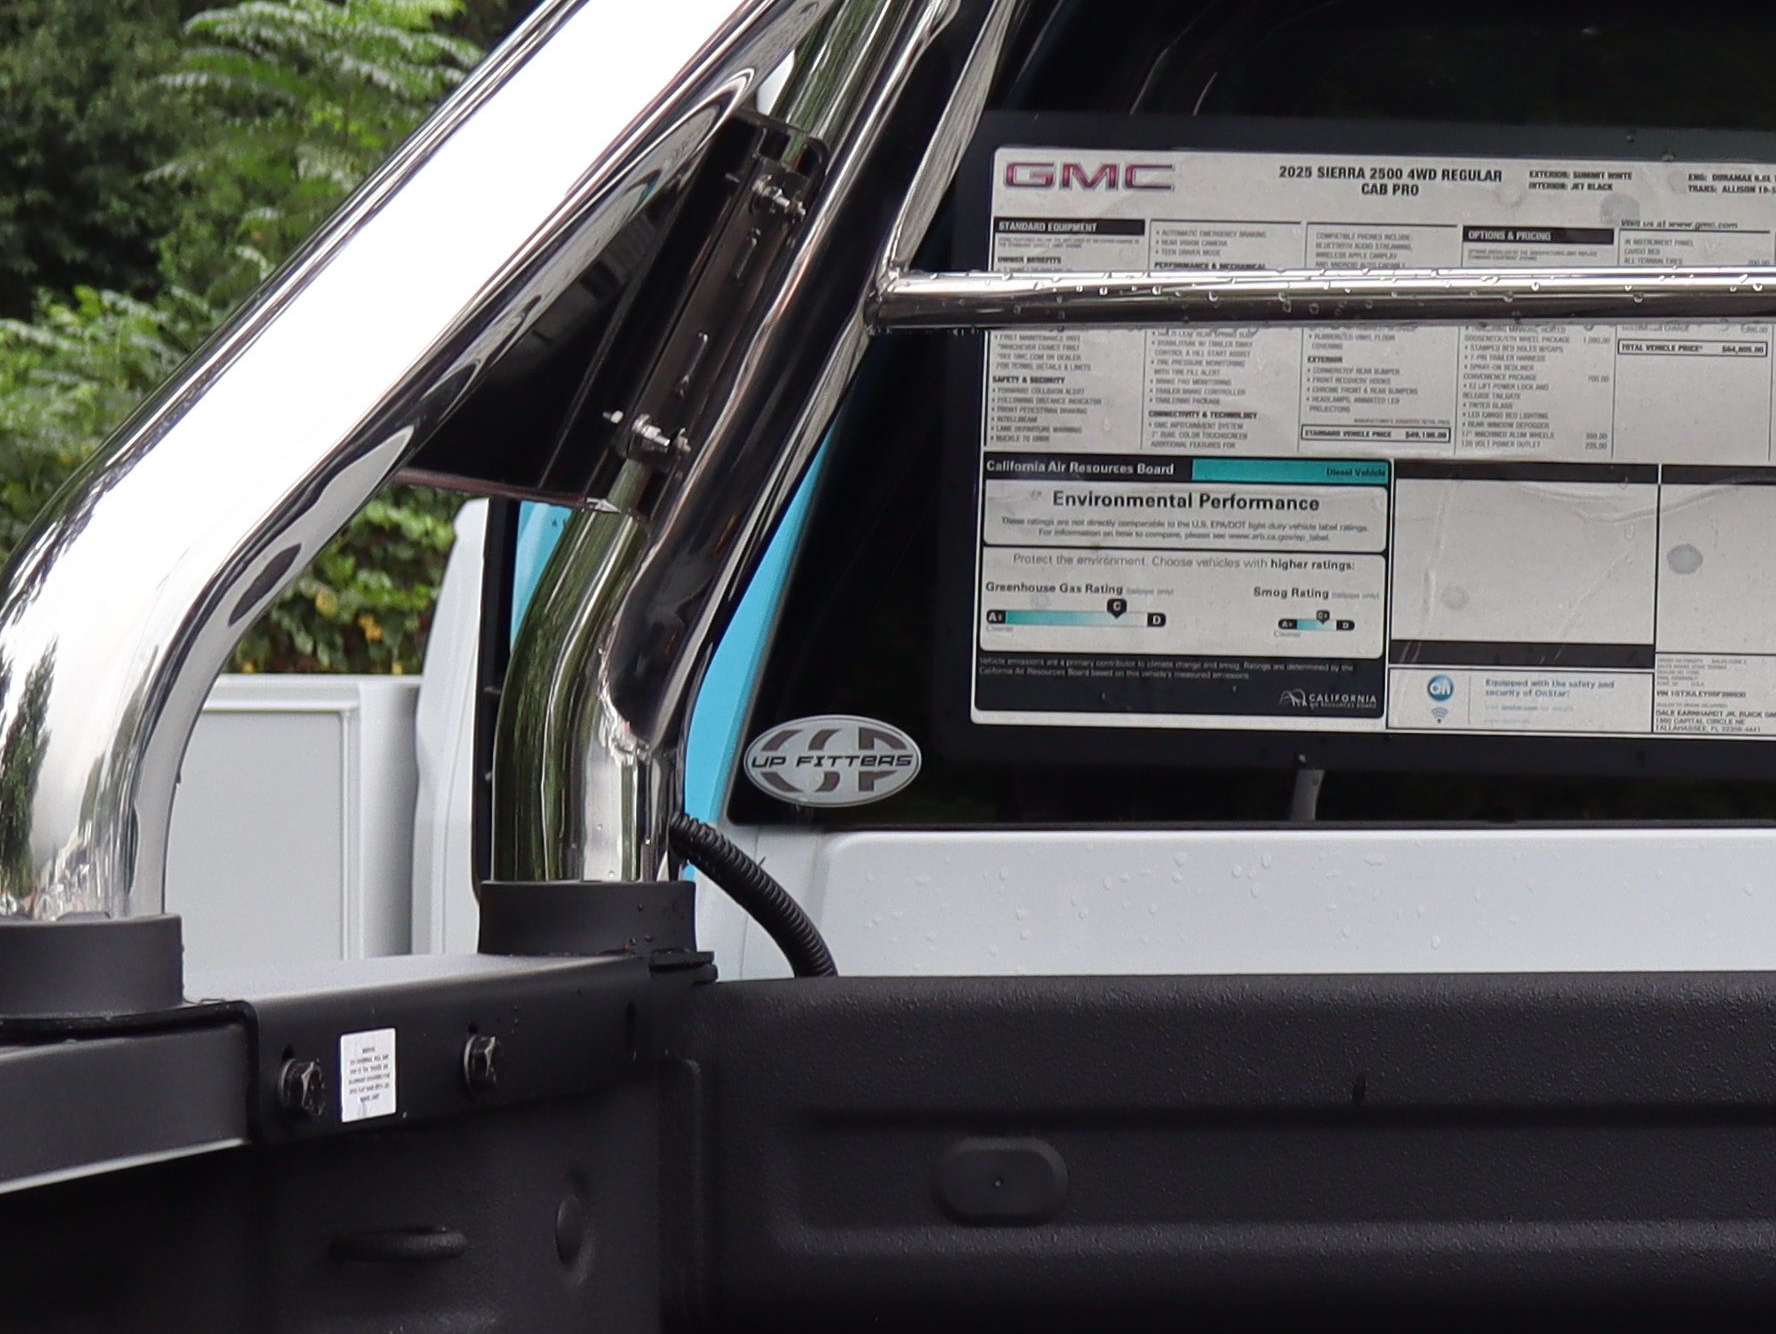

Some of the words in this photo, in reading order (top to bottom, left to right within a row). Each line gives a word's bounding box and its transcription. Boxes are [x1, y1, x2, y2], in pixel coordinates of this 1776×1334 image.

[1004, 162, 1174, 191] GMC
[1279, 166, 1312, 179] 2025
[1317, 167, 1366, 180] SIERRA
[1370, 168, 1403, 181] 2500
[1407, 168, 1437, 181] 4WD
[1441, 169, 1502, 183] REGULAR
[1529, 171, 1571, 179] EXTERIOR:
[1573, 171, 1605, 180] SUMMIT
[1608, 172, 1632, 181] WHITE
[1688, 173, 1708, 182] ENG:
[1712, 174, 1752, 183] DURAMAX
[1361, 183, 1388, 196] CAB
[1393, 184, 1420, 197] PRO
[1528, 182, 1568, 191] INTERIOR:
[1570, 183, 1585, 191] JET
[1588, 183, 1614, 191] BLACK
[1688, 185, 1718, 194] TRANS:
[1722, 185, 1756, 194] ALLISON
[999, 221, 1046, 232] STANDARD
[1048, 222, 1098, 233] EQUIPMENT
[1621, 220, 1640, 228] Visit
[1643, 220, 1654, 228] us
[1657, 221, 1666, 229] at
[1468, 230, 1506, 241] OPTIONS
[1507, 231, 1514, 241] &
[1516, 231, 1552, 242] PRICING
[998, 256, 1024, 264] OWNER
[1026, 256, 1062, 265] BENEFITS
[1621, 344, 1643, 352] TOTAL
[1646, 345, 1676, 353] VEHICLE
[992, 376, 1020, 384] SAFETY
[1030, 377, 1066, 385] SECURITY
[1149, 411, 1200, 419] CONNECTIVITY
[1210, 412, 1258, 420] TECHNOLOGY
[1305, 430, 1340, 438] STANDARD
[1343, 430, 1370, 438] VEHICLE
[986, 461, 1046, 473] California
[1048, 462, 1066, 474] Air
[1070, 462, 1134, 475] Resources
[1137, 463, 1174, 476] Board
[1326, 468, 1352, 477] Diesel
[1355, 468, 1386, 478] Vehicle
[1053, 491, 1192, 509] Environmental
[1200, 492, 1320, 511] Performance
[1013, 553, 1052, 565] Protect
[1056, 554, 1074, 565] the
[1152, 556, 1194, 568] Choose
[1196, 557, 1240, 569] vehicles
[1243, 558, 1268, 569] with
[1270, 559, 1308, 570] higher
[1311, 559, 1356, 571] ratings:
[985, 582, 1056, 594] Greenhouse
[1059, 584, 1082, 595] Gas
[1085, 585, 1124, 595] Rating
[1254, 587, 1288, 600] Smog
[1291, 588, 1330, 600] Rating
[1113, 601, 1122, 611] C
[1152, 615, 1161, 625] D
[1485, 678, 1528, 689] Equipped
[1531, 679, 1550, 689] with
[1552, 679, 1566, 689] the
[1569, 679, 1595, 689] safety
[1598, 680, 1614, 690] and
[1485, 688, 1520, 698] security
[1523, 689, 1533, 698] of
[1309, 693, 1377, 704] CALIFORNIA
[751, 755, 786, 767] UP
[797, 755, 913, 767] FITTERS
